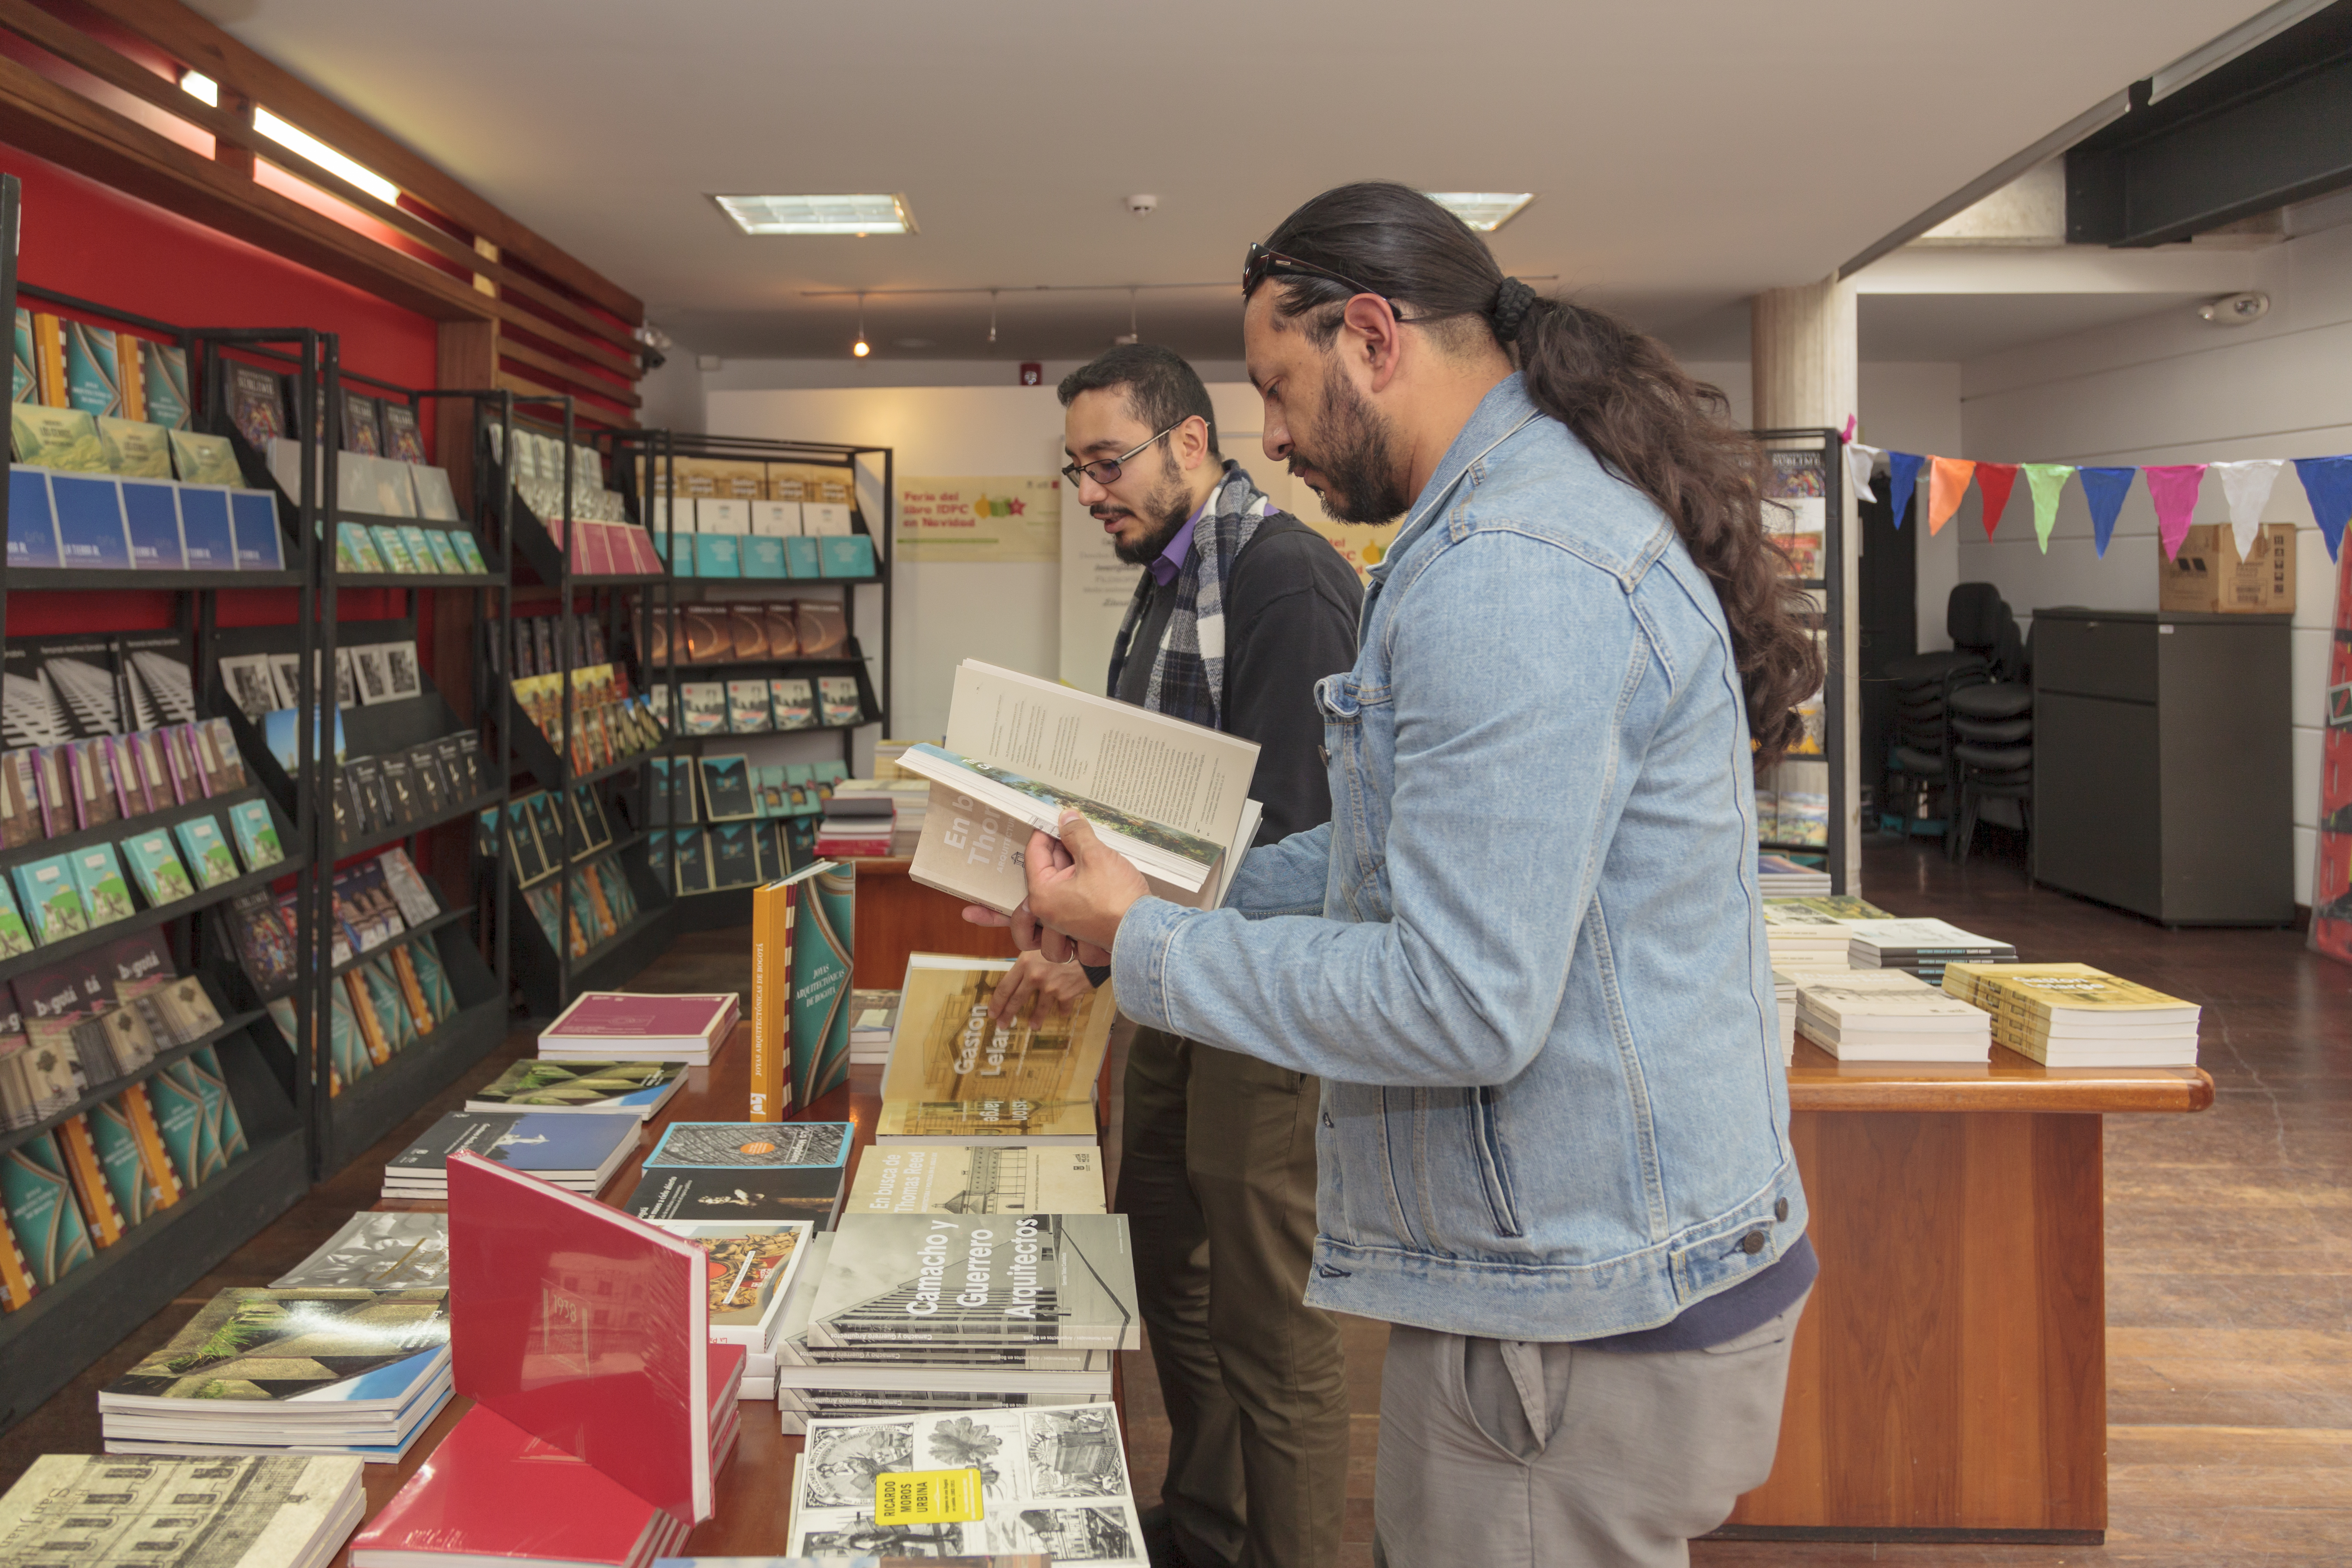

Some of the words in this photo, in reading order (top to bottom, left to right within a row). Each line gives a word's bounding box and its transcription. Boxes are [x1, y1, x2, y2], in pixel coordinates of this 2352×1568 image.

[1772, 457, 1821, 466] SUBLIME
[903, 492, 934, 501] Feria
[939, 492, 959, 501] del
[903, 504, 931, 514] libro
[936, 504, 968, 515] IDPC
[923, 518, 975, 528] Navidad
[756, 973, 763, 984] DE
[813, 964, 829, 979] JOYAS
[796, 969, 844, 1000] ARQUITECTÓNICAS
[806, 996, 814, 1007] DE
[815, 983, 836, 1003] BOGOTÁ
[954, 1003, 988, 1074] Gaston
[980, 1014, 1017, 1076] Lelar
[979, 1101, 1002, 1122] large
[1011, 1100, 1029, 1120] aston
[789, 1140, 807, 1162] Magdalena
[882, 1155, 901, 1165] de
[903, 1152, 925, 1174] Reed
[663, 1176, 677, 1190] abierto
[873, 1168, 898, 1195] busca
[658, 1190, 670, 1199] cielo
[869, 1197, 890, 1208] En
[894, 1177, 920, 1212] Thomas
[921, 1191, 930, 1212] ARQUITECTURA
[650, 1202, 663, 1214] museo
[905, 1234, 948, 1315] Camacho
[931, 1220, 958, 1229] y
[956, 1229, 993, 1307] Guerrero
[1004, 1218, 1043, 1318] Arquitectos
[553, 1294, 576, 1322] 1938
[809, 1441, 830, 1466] INDUSTRIAL
[825, 1481, 836, 1491] GRAN
[839, 1432, 870, 1443] CIGARRILLOS
[808, 1468, 825, 1493] COLOMBIA
[31, 1488, 70, 1514] San
[884, 1481, 895, 1516] RICARDO
[900, 1483, 911, 1512] MOROS
[917, 1482, 928, 1512] URBINA
